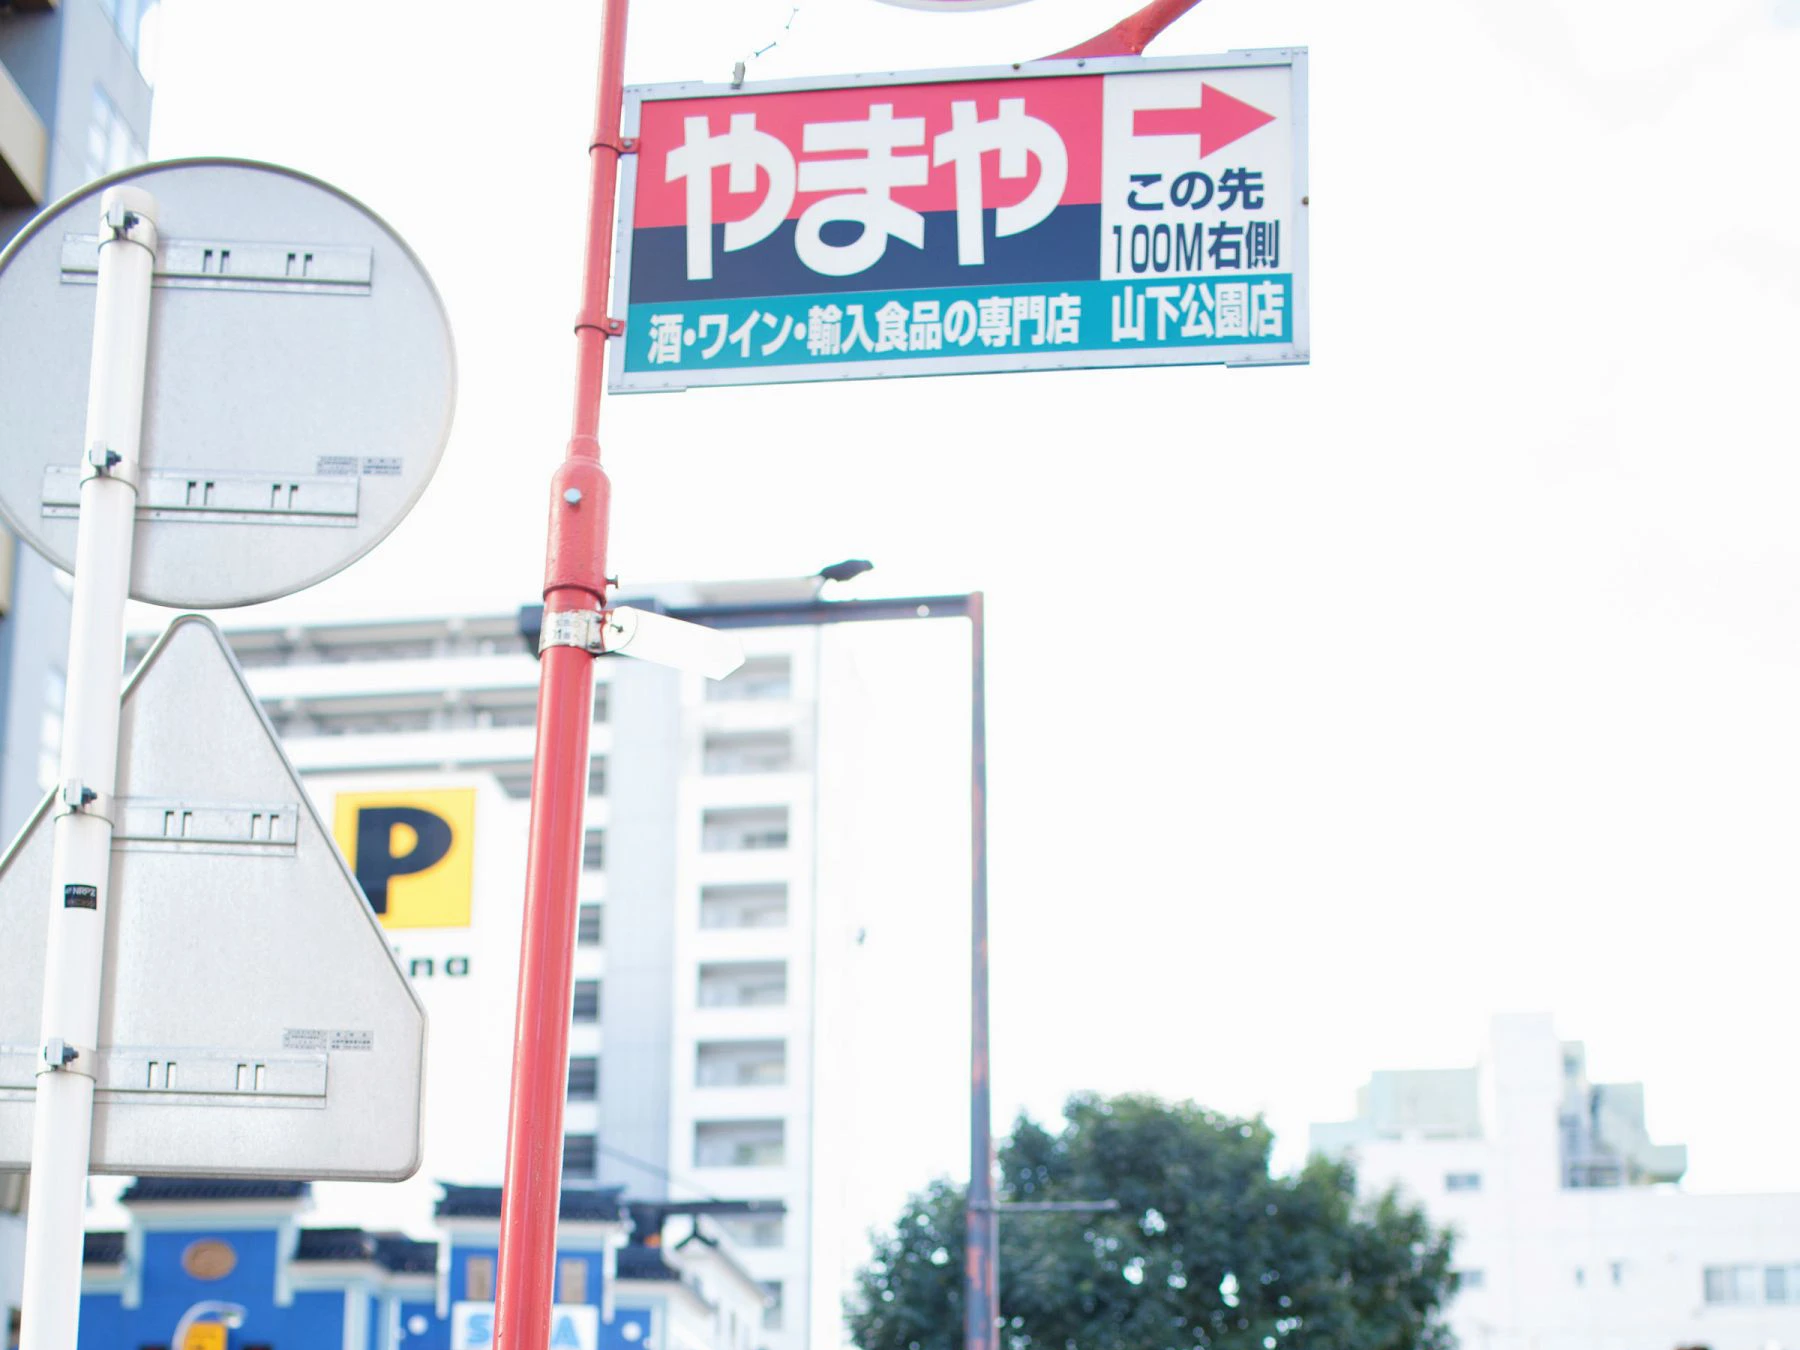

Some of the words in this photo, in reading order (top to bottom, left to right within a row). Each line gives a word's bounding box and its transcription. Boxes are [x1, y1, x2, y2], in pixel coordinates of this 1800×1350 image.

[665, 98, 1069, 281] やまや
[1127, 167, 1264, 211] この先
[1112, 219, 1280, 274] 100M右側
[1111, 281, 1285, 342] 山下公園店
[355, 807, 453, 914] P
